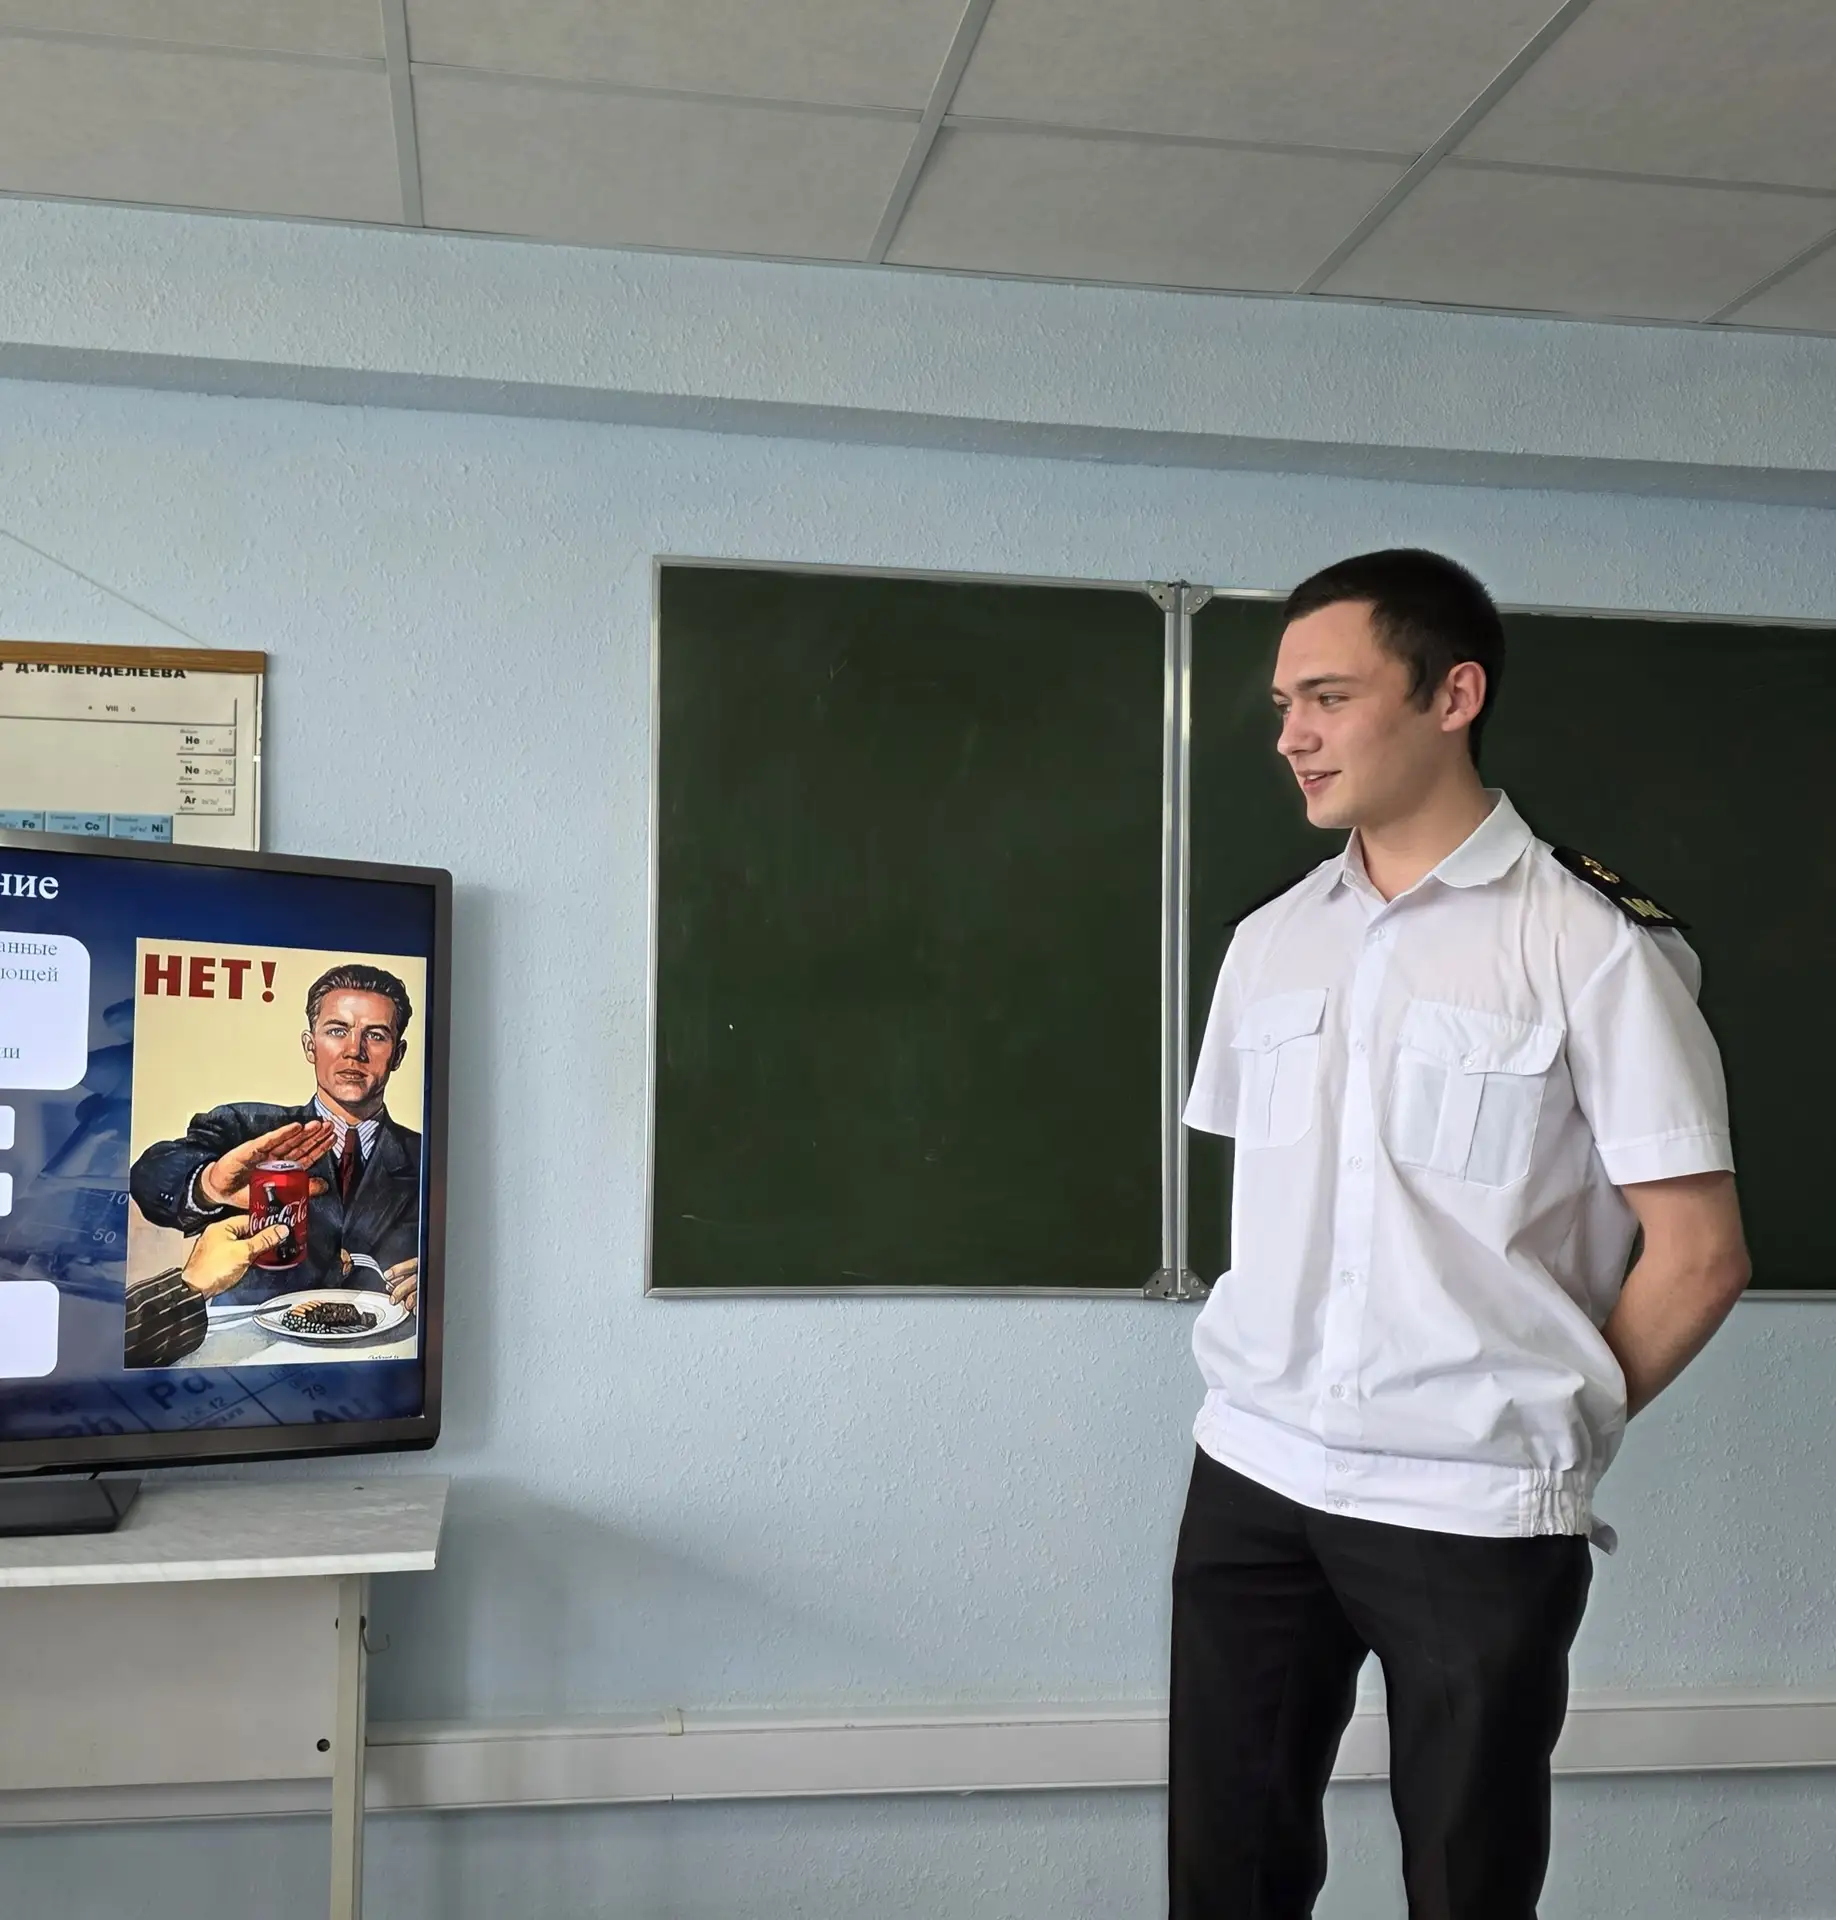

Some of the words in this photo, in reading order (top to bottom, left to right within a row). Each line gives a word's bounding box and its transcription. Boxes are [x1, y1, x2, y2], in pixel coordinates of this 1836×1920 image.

[185, 736, 200, 744] He
[185, 766, 200, 774] Ne
[184, 795, 197, 804] Ar
[22, 820, 35, 829] Fe
[85, 822, 100, 831] Co
[151, 824, 164, 833] Ni
[143, 953, 277, 1003] НЕТ!
[108, 1191, 128, 1205] 10
[93, 1228, 116, 1244] 50
[302, 1382, 327, 1402] 79
